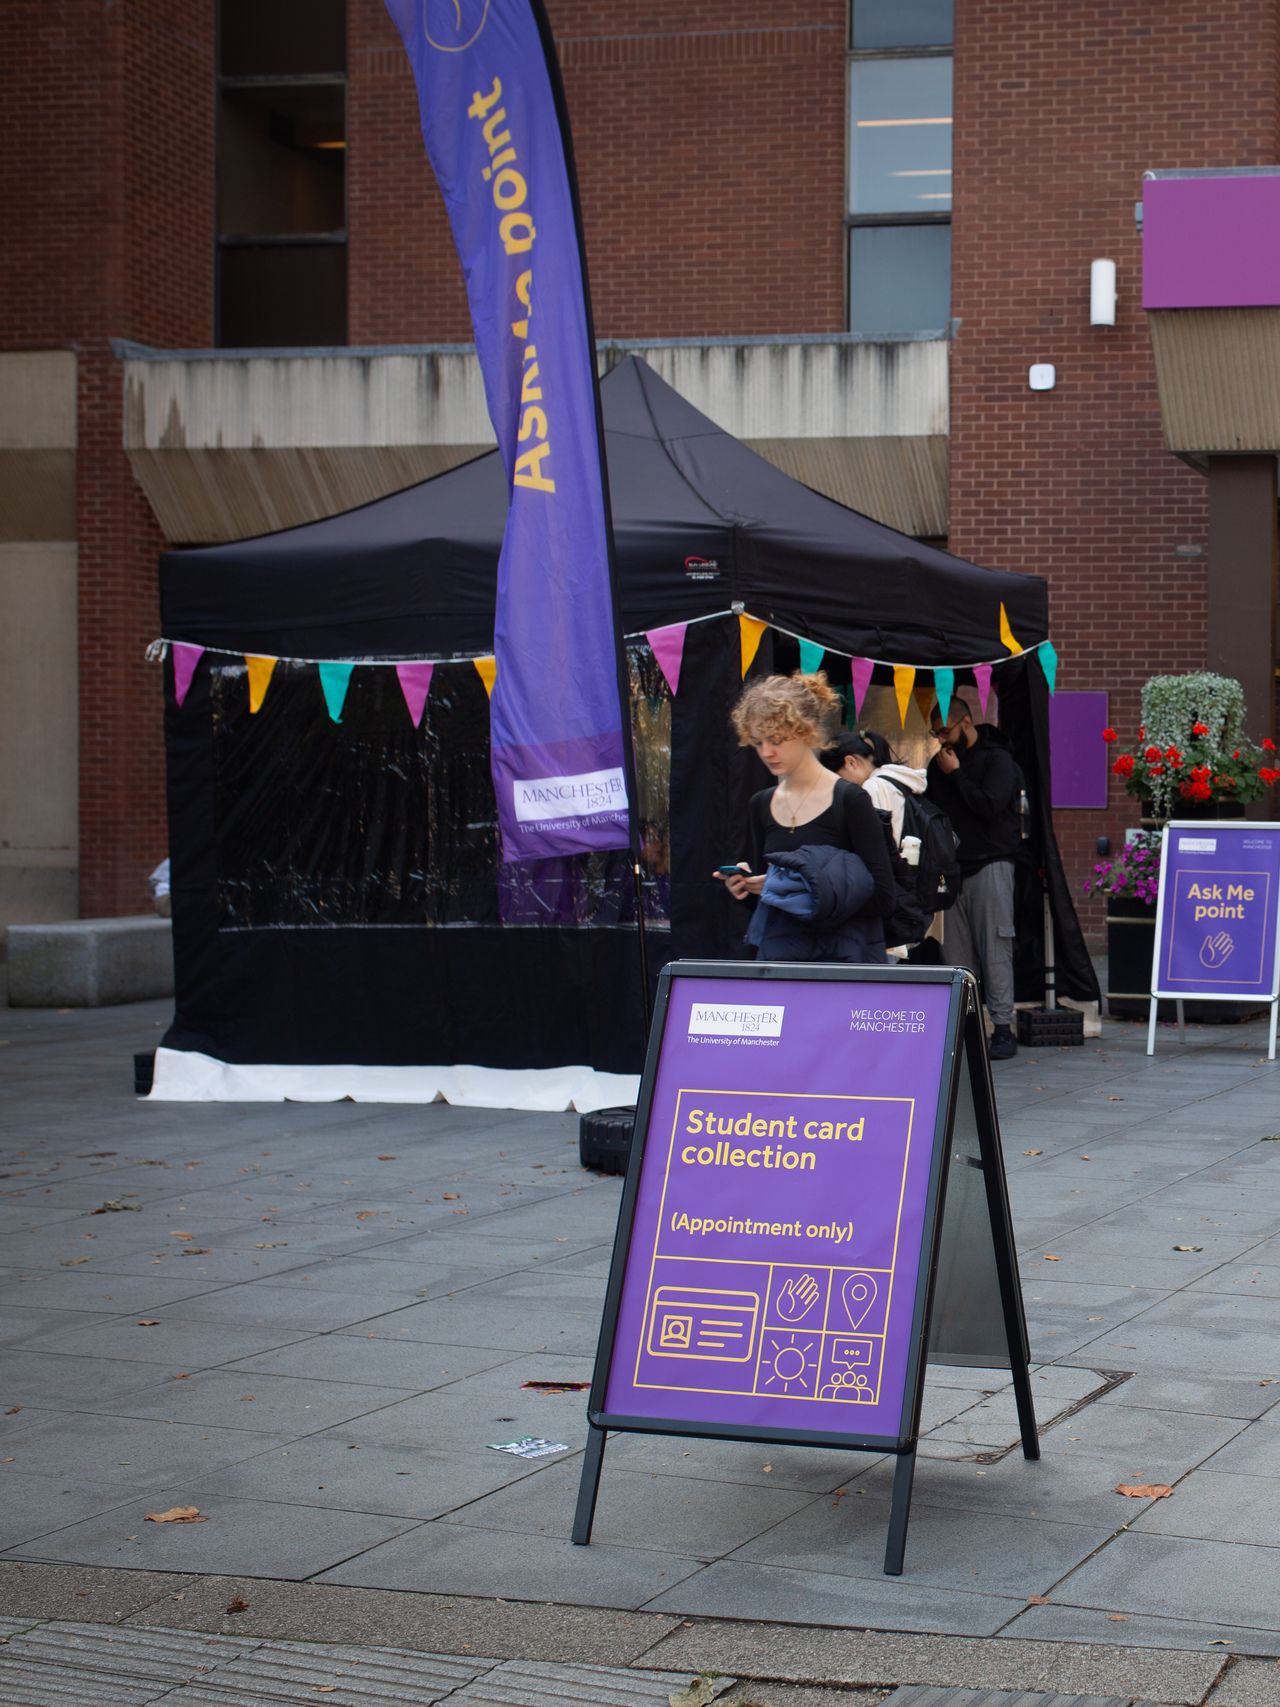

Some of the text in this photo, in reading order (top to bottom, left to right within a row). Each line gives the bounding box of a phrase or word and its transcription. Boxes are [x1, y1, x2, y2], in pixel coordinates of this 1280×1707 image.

[467, 75, 537, 256] point
[522, 777, 624, 804] MANCHESTER
[586, 795, 612, 809] 1824
[518, 824, 535, 834] The
[535, 818, 581, 832] University
[582, 817, 591, 827] of
[1187, 883, 1255, 902] Ask Me
[1194, 903, 1245, 922] point
[695, 1010, 778, 1024] MANCHESTER
[851, 1009, 926, 1022] WELCOME TO
[741, 1023, 760, 1032] 1824
[850, 1021, 926, 1033] MANCHESTER
[687, 1035, 780, 1047] The University of Manchester
[686, 1109, 865, 1142] Student card
[681, 1141, 817, 1170] collection
[670, 1211, 854, 1244] (Appointment only)
